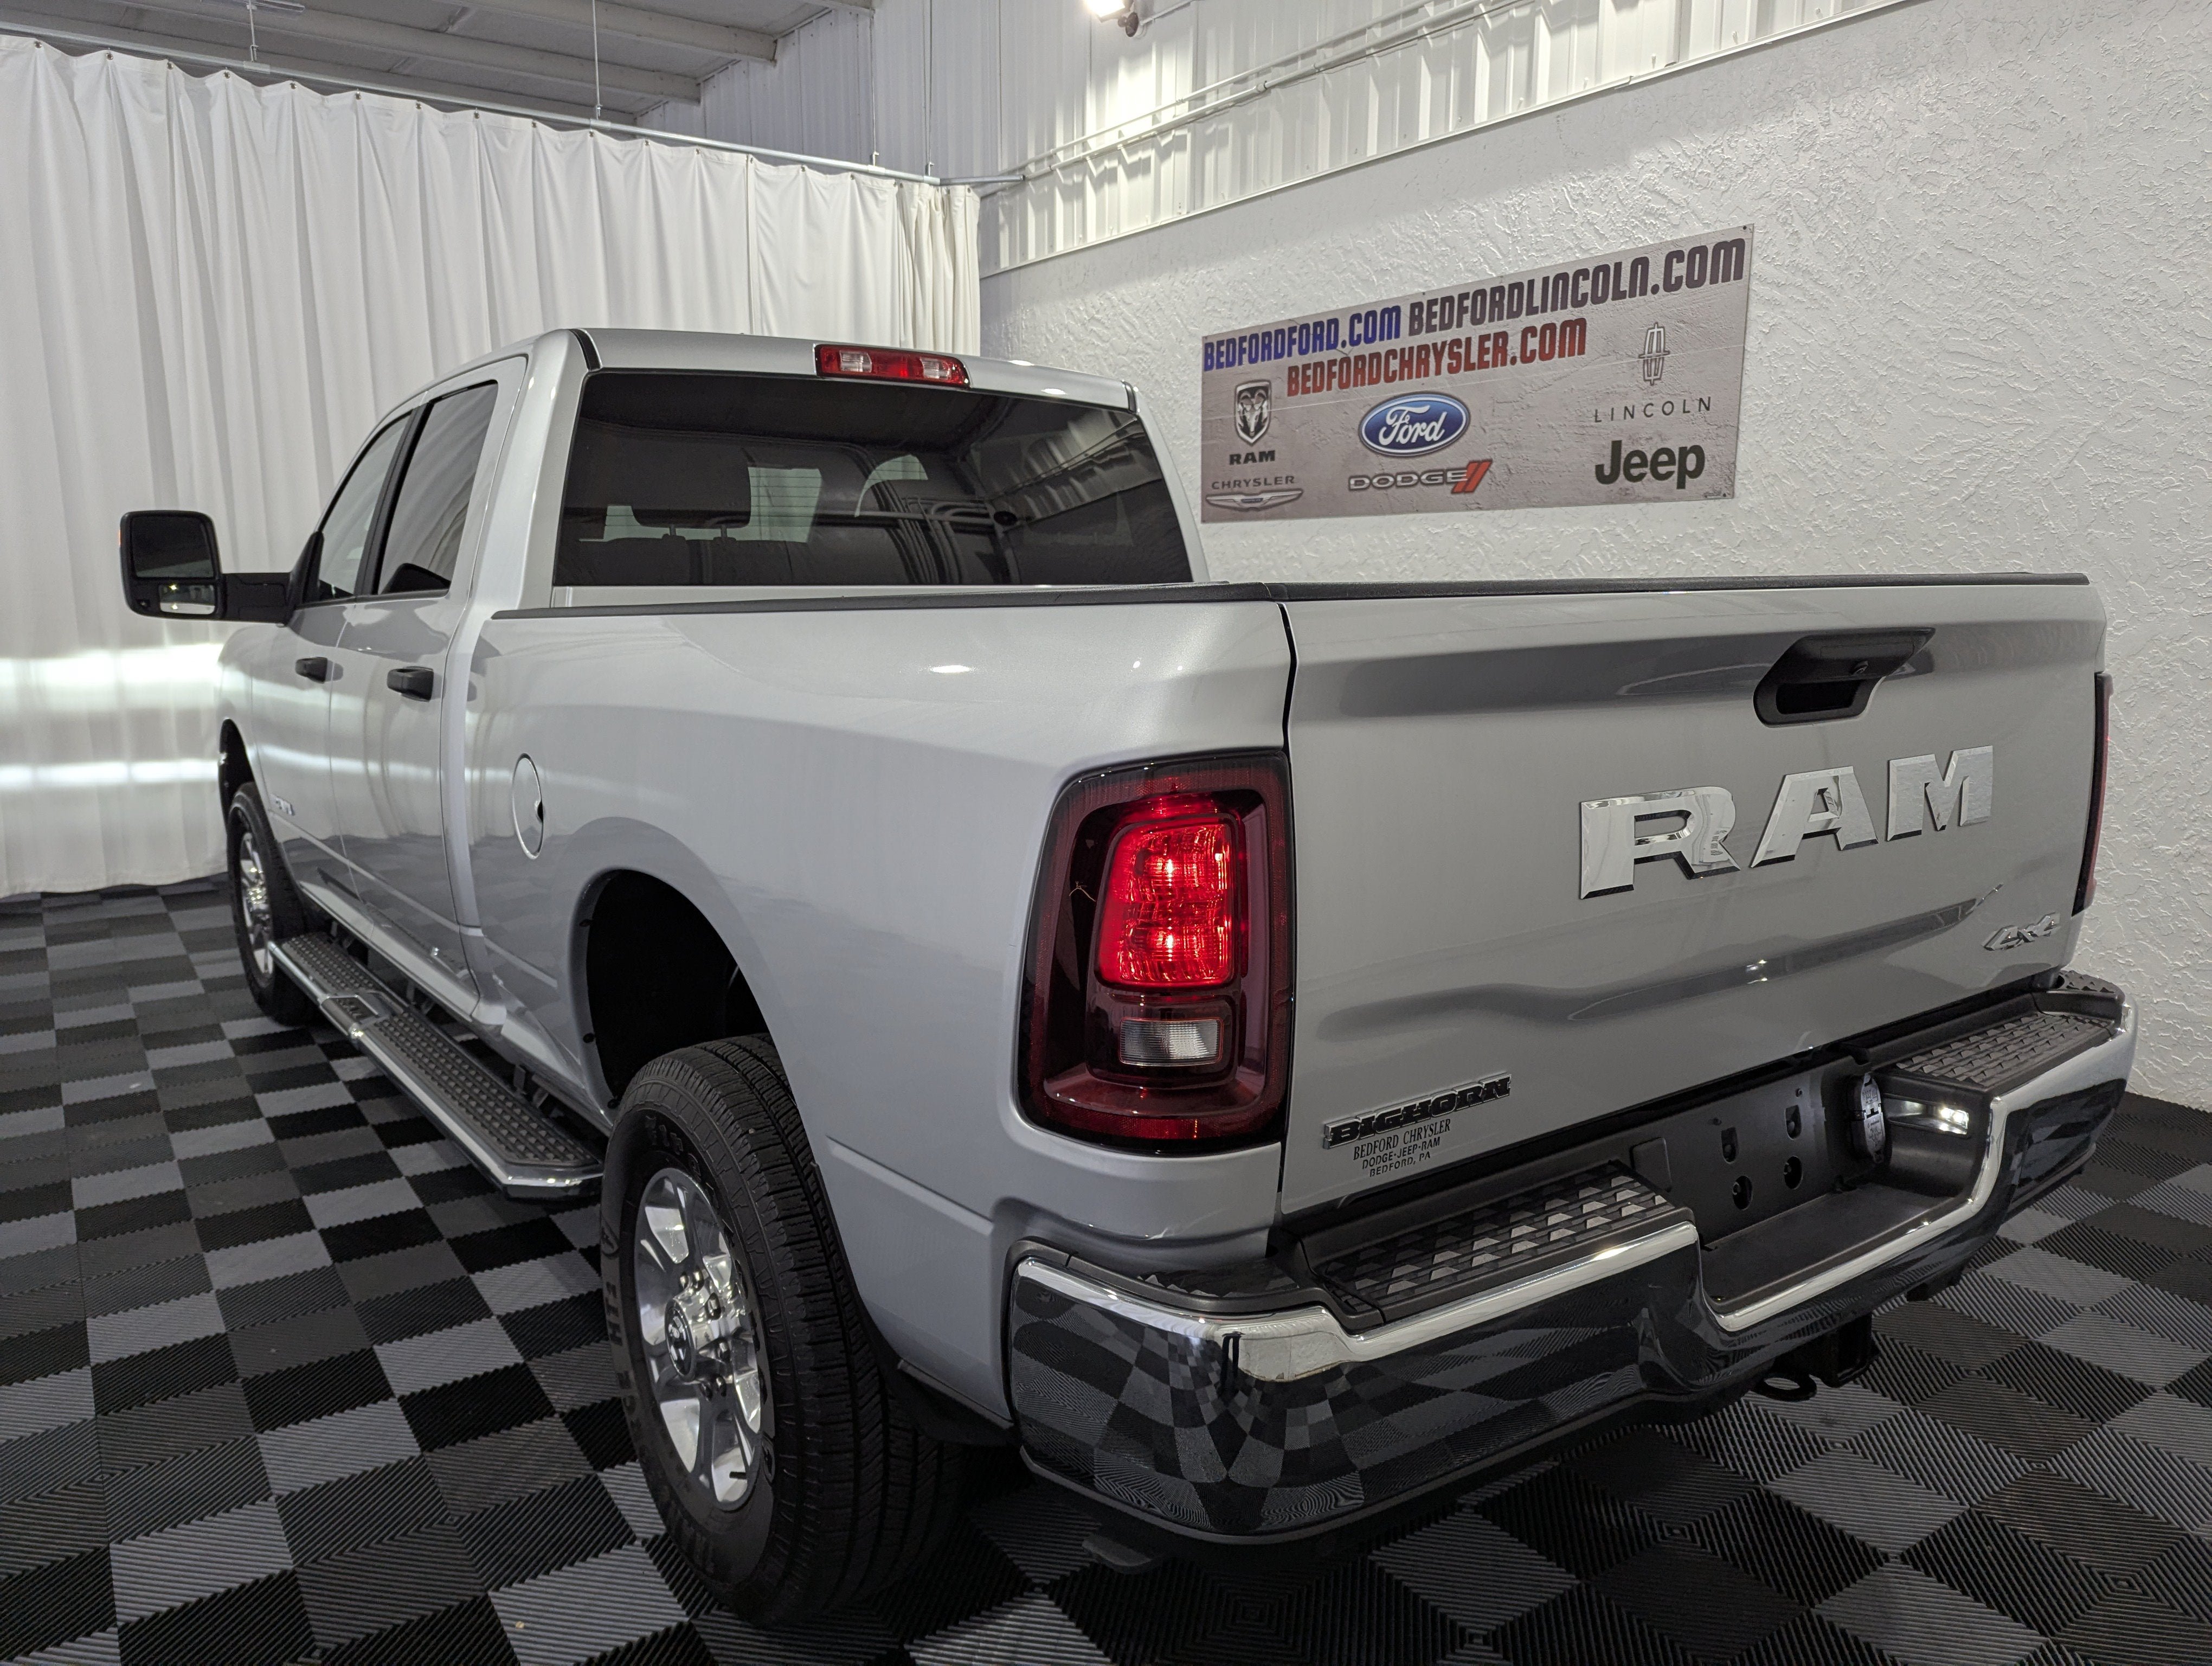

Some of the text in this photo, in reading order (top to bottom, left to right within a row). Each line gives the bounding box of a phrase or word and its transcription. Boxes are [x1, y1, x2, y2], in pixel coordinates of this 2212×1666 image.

[1204, 237, 1746, 373] BEDFORDFORD.COM BEDFORDLINCOLN.COM
[1287, 317, 1587, 398] BEDFORDCHRYSLER.COM
[1378, 405, 1448, 445] Ford
[1593, 395, 1713, 424] LINCOLN
[1229, 450, 1276, 465] RAM
[1594, 439, 1706, 490] Jeep
[1211, 475, 1295, 490] CHRYSLER
[1348, 468, 1468, 491] DODGE
[1580, 745, 1994, 900] RAM
[1353, 1118, 1451, 1161] BEDFORD CHRYSLER
[1369, 1151, 1431, 1178] BEDFORD, PA
